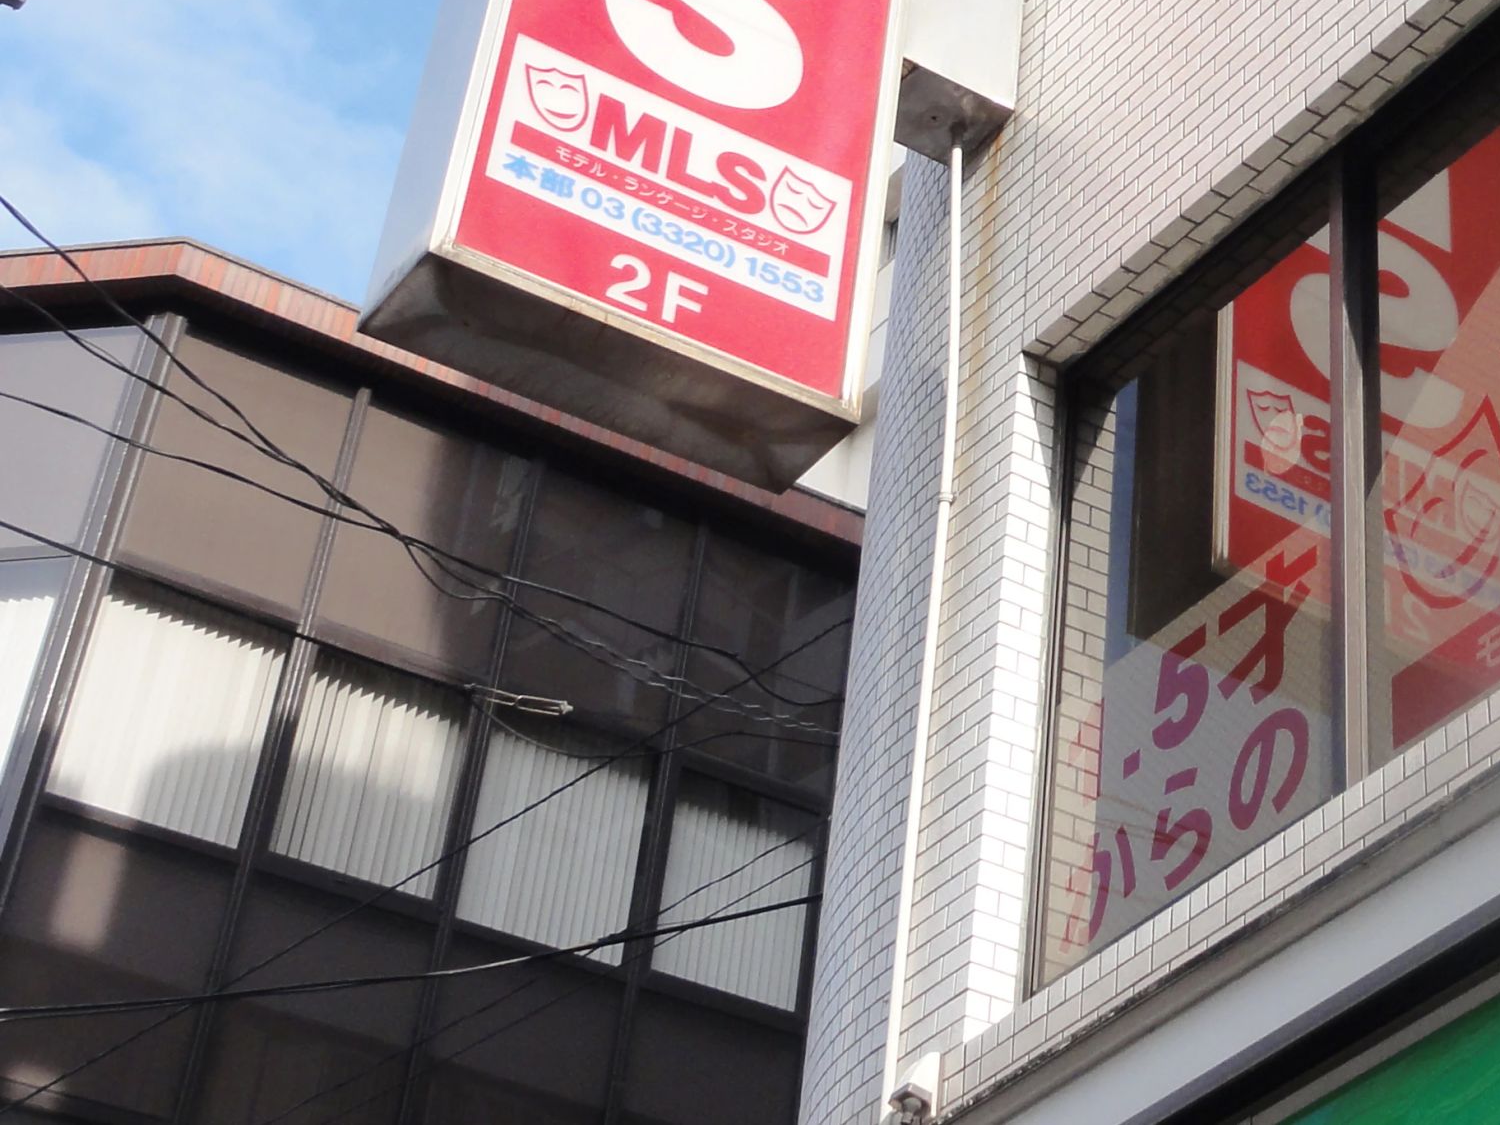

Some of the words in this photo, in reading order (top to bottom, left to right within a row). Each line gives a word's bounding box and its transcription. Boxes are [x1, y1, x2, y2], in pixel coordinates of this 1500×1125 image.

[590, 92, 767, 215] MLS
[502, 152, 575, 199] 本部
[580, 186, 626, 220] 03
[631, 206, 736, 268] (3320)
[744, 256, 824, 304] 1553
[604, 252, 709, 324] 2F
